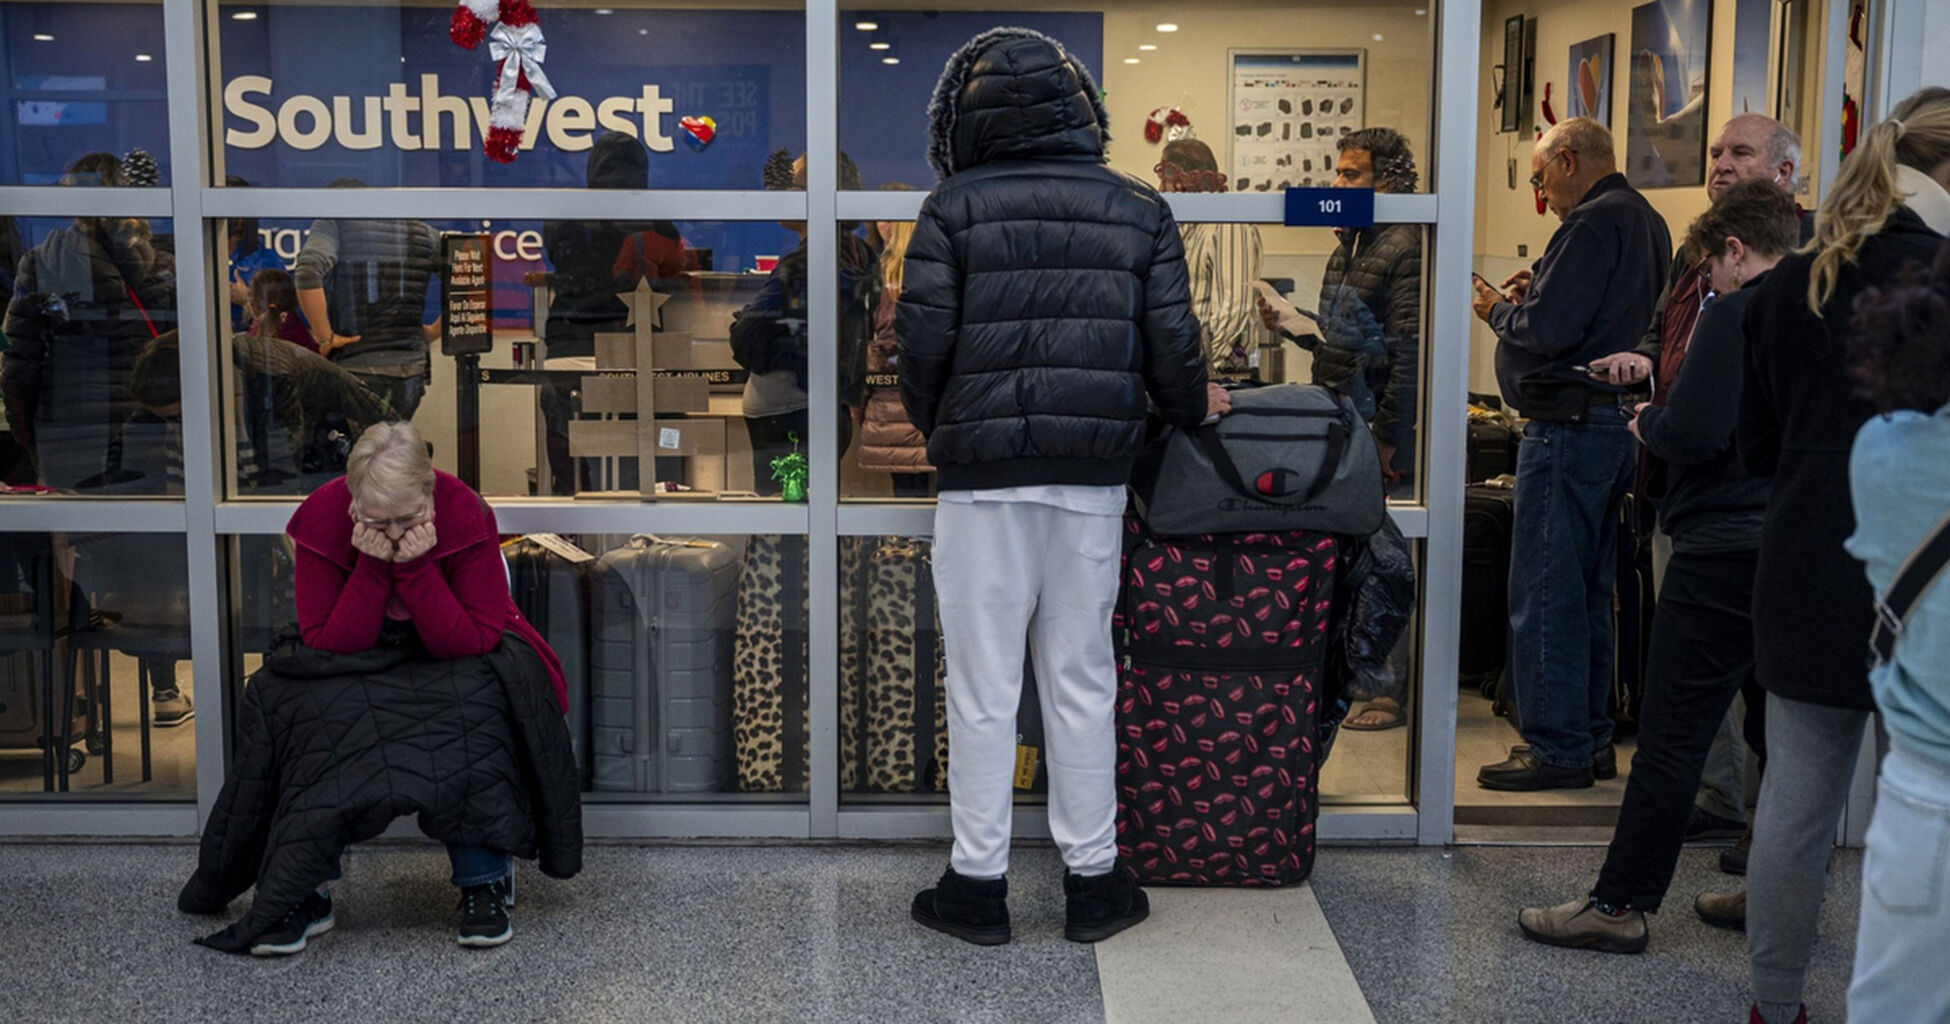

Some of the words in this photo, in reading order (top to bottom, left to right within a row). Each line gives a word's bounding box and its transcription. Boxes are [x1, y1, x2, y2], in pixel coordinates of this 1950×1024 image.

[1318, 199, 1342, 213] 101
[454, 250, 470, 261] Please
[470, 250, 481, 260] Wait
[464, 262, 472, 273] For
[472, 262, 484, 273] Next
[451, 275, 470, 285] Available
[471, 275, 485, 287] Agent
[865, 374, 899, 385] WEST
[1218, 497, 1328, 518] Champion
